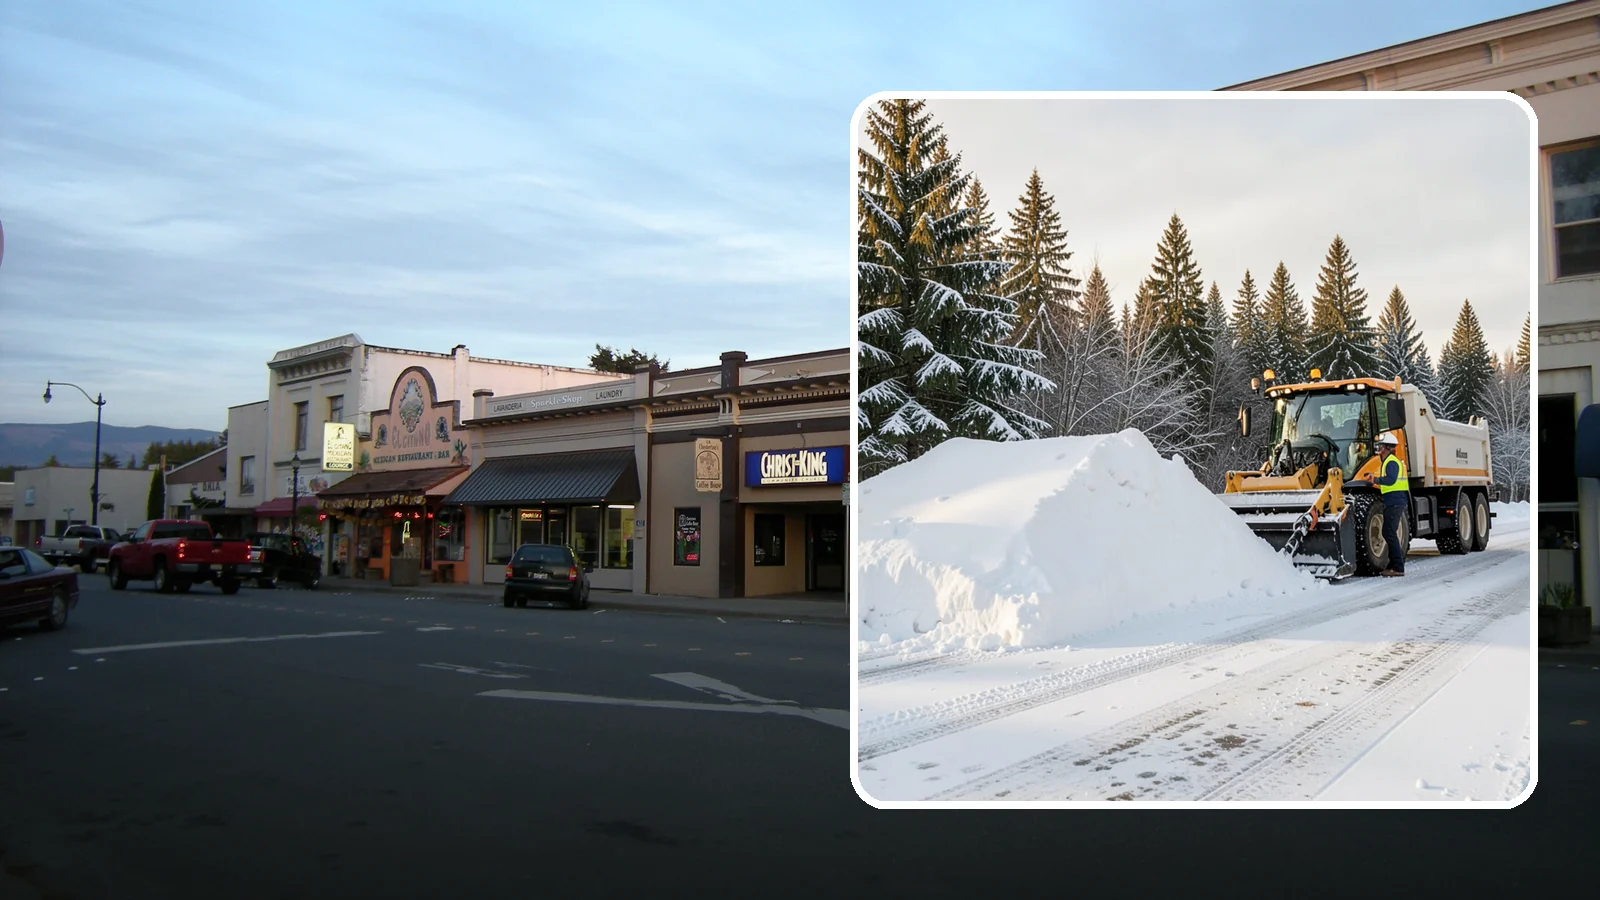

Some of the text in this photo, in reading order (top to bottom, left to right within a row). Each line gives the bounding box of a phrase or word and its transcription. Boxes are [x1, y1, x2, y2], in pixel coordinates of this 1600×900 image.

[596, 389, 624, 400] LAUNDRY
[494, 403, 522, 412] LAVANDERIA
[530, 394, 583, 409] Sparkle Shop
[373, 455, 396, 464] MEXICAN
[397, 451, 433, 462] RESTAURANT
[438, 450, 450, 459] BAR
[761, 450, 827, 478] CHRIST KING
[696, 480, 721, 489] Coffee House
